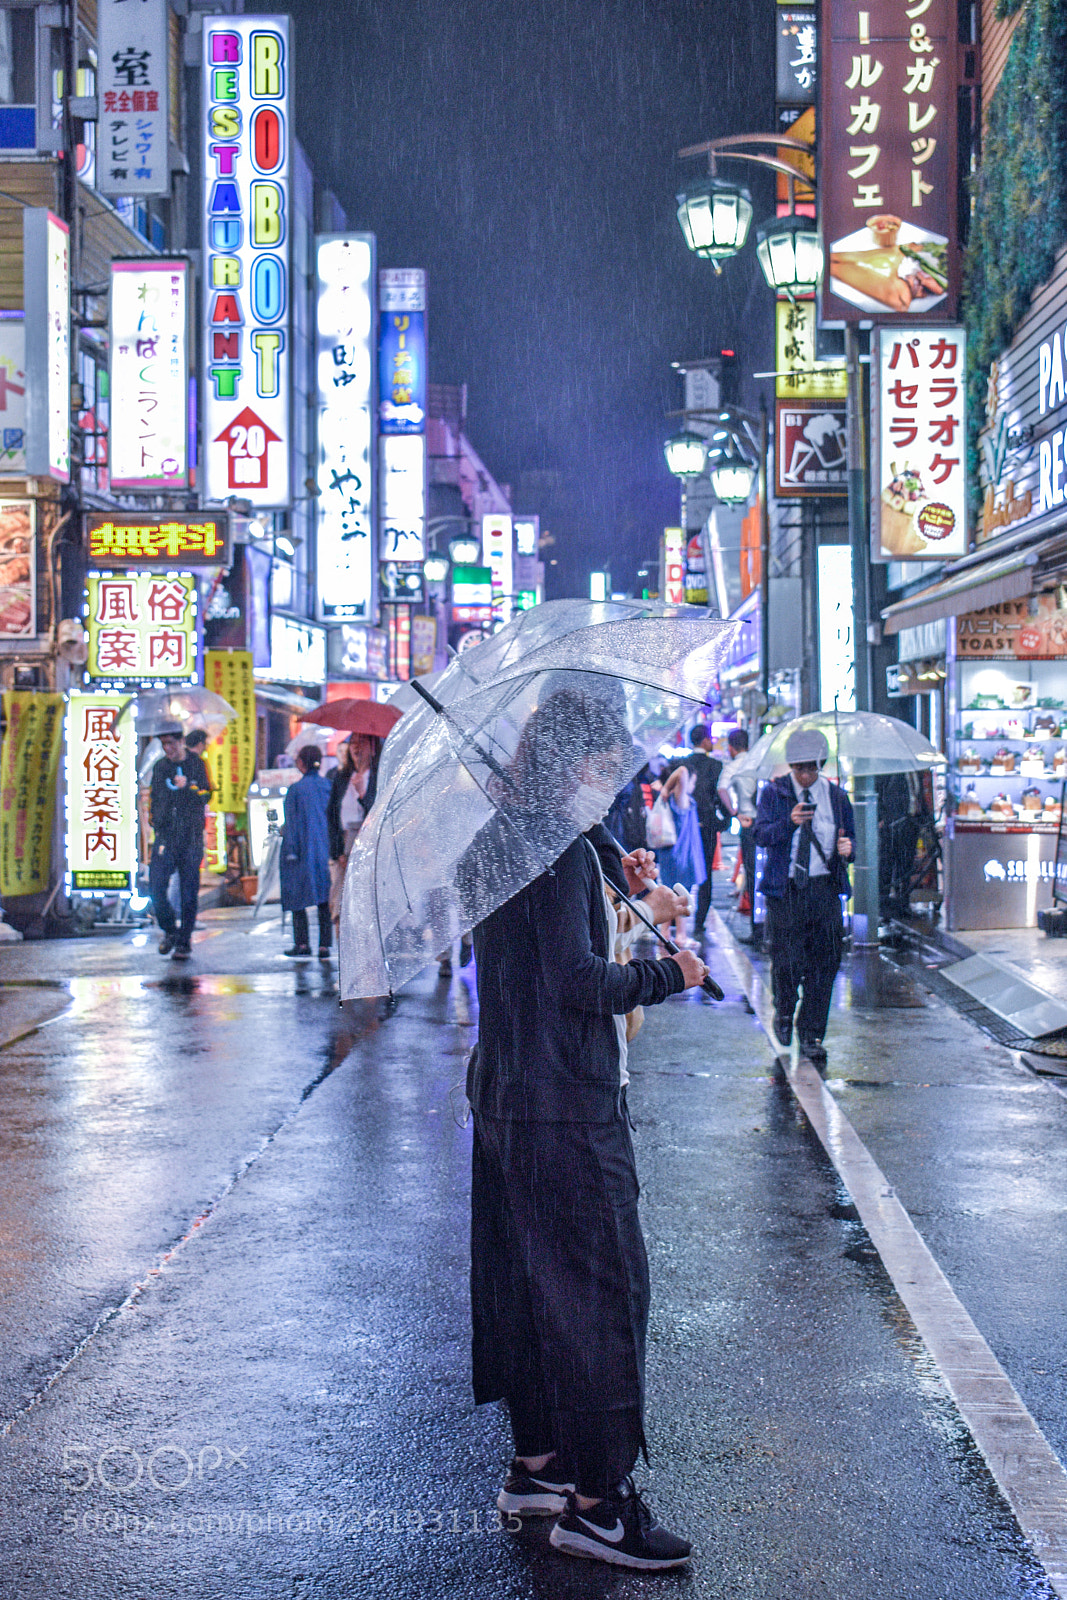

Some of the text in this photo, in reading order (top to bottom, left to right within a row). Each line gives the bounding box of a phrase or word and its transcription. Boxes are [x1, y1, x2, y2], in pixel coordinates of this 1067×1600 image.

[104, 90, 159, 113] 完全個室
[779, 110, 801, 123] 4F
[110, 120, 129, 180] テレビ有
[134, 119, 154, 180] シャワー有
[208, 31, 244, 399] RESTAURANT
[248, 30, 286, 399] ROBOT
[888, 338, 920, 449] パセラ
[929, 338, 960, 485] カラオケ
[229, 426, 266, 457] 20
[90, 522, 224, 557] 無料
[97, 582, 188, 623] 風俗
[958, 618, 1023, 635] ハニトー
[959, 638, 1015, 651] TOAST
[98, 629, 184, 670] 案内
[82, 706, 121, 862] 風俗案内
